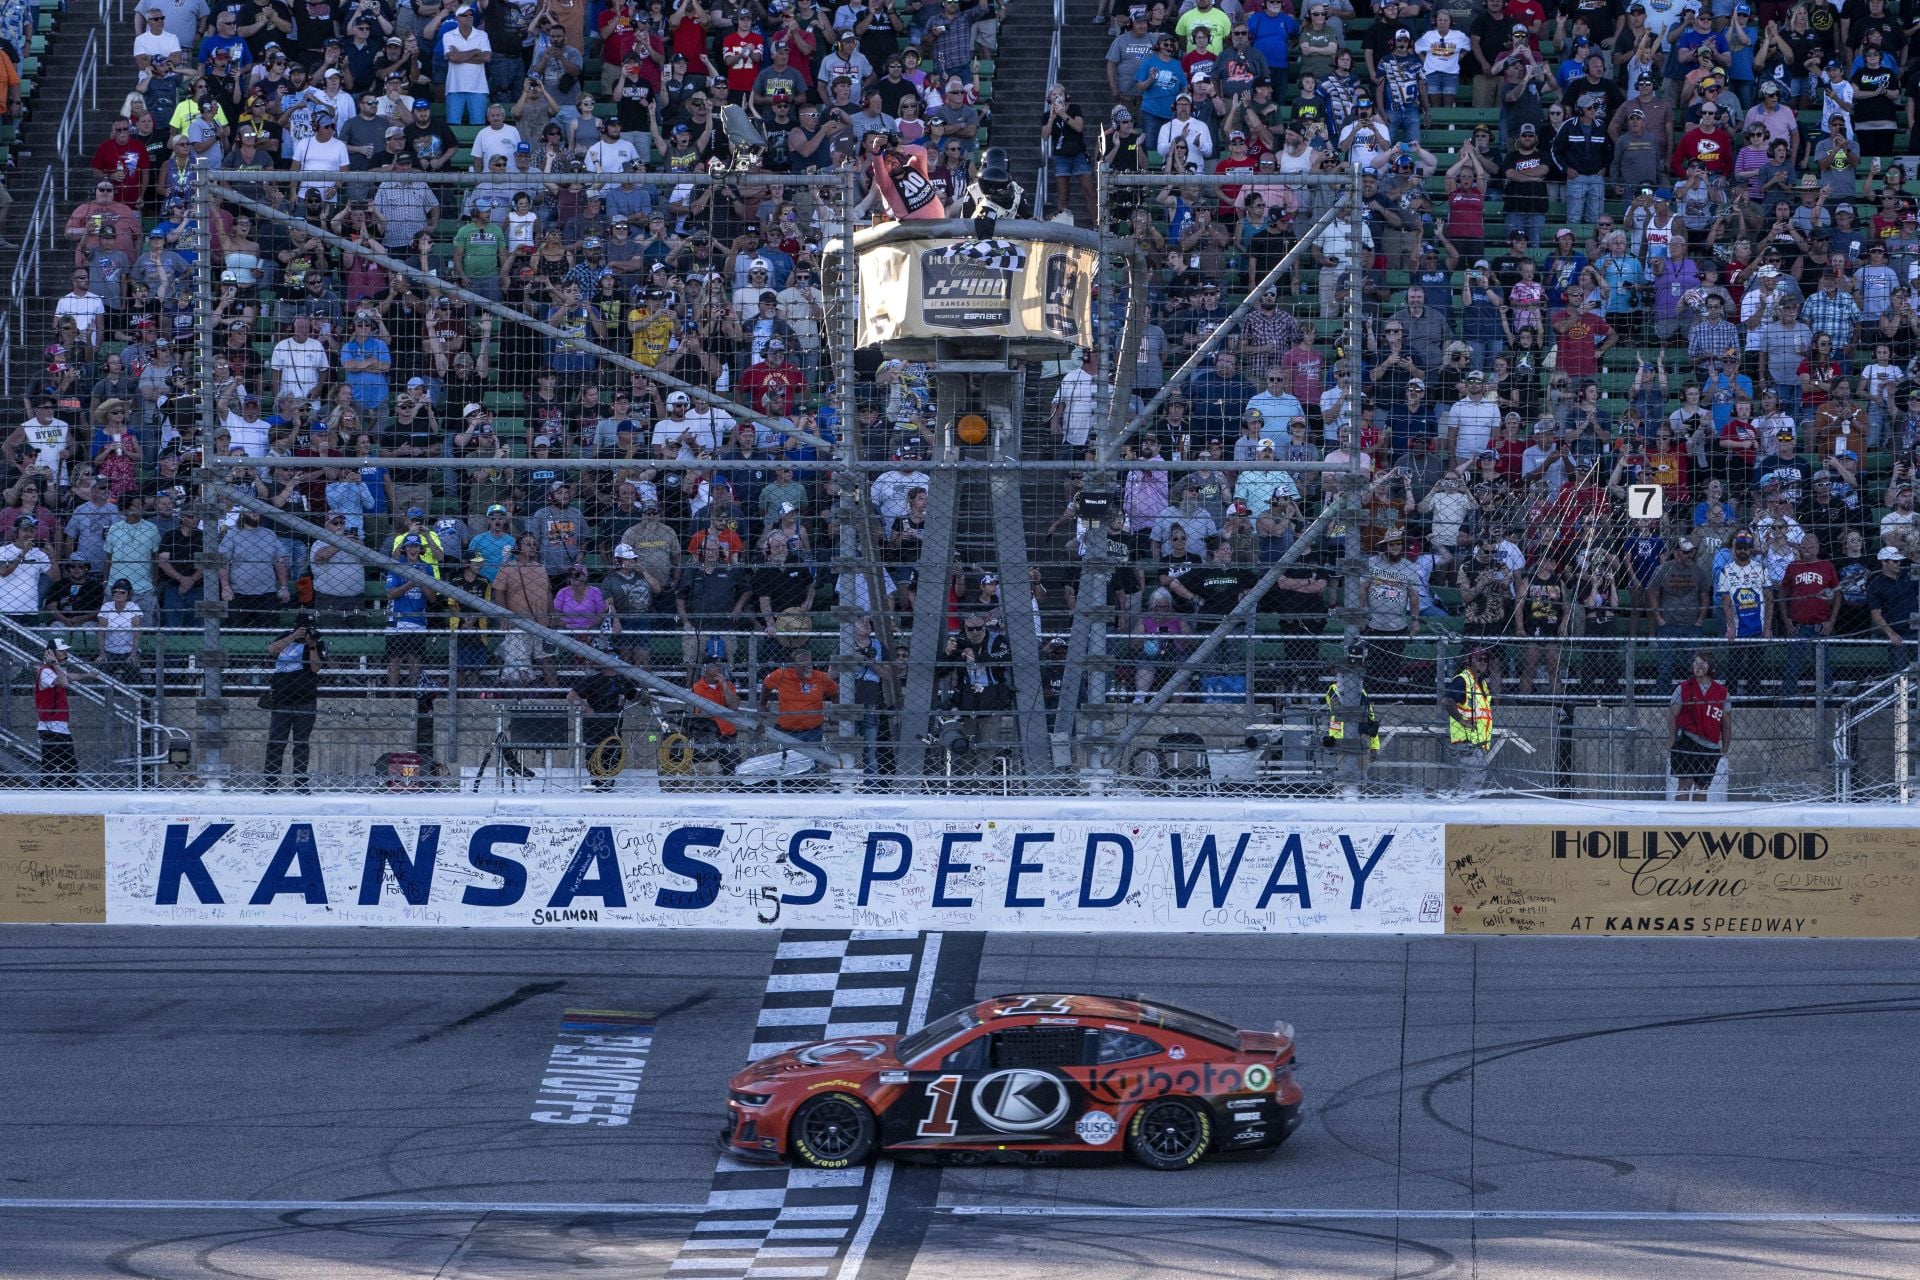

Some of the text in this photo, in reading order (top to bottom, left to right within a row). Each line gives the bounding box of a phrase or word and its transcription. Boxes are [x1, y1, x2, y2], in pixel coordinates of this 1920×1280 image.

[1861, 74, 1891, 82] ELLIOTT
[1697, 153, 1721, 161] CHIEFS
[961, 278, 1008, 296] 400
[35, 428, 63, 440] BYRON
[1634, 486, 1657, 513] 7
[1795, 571, 1824, 585] CHIEFS
[616, 829, 657, 855] Craig
[727, 822, 789, 851] Jace
[1552, 830, 1829, 860] HOLLYWOOD
[155, 823, 1395, 910] KANSAS SPEEDWAY
[1619, 849, 1749, 896] Casino
[1774, 872, 1842, 887] GO DENNY
[1863, 874, 1890, 888] GO
[1490, 895, 1526, 905] Michael
[532, 908, 598, 926] SOLAMON
[1203, 908, 1229, 926] GO
[1497, 907, 1513, 915] GO
[1571, 917, 1806, 932] AT KANSAS SPEEDWAY
[530, 1031, 653, 1127] PLAYOFFS
[1089, 1062, 1243, 1099] Kubota
[916, 1074, 964, 1137] 1
[1076, 1121, 1118, 1134] BUSCH
[796, 1139, 849, 1168] GOODYEAR
